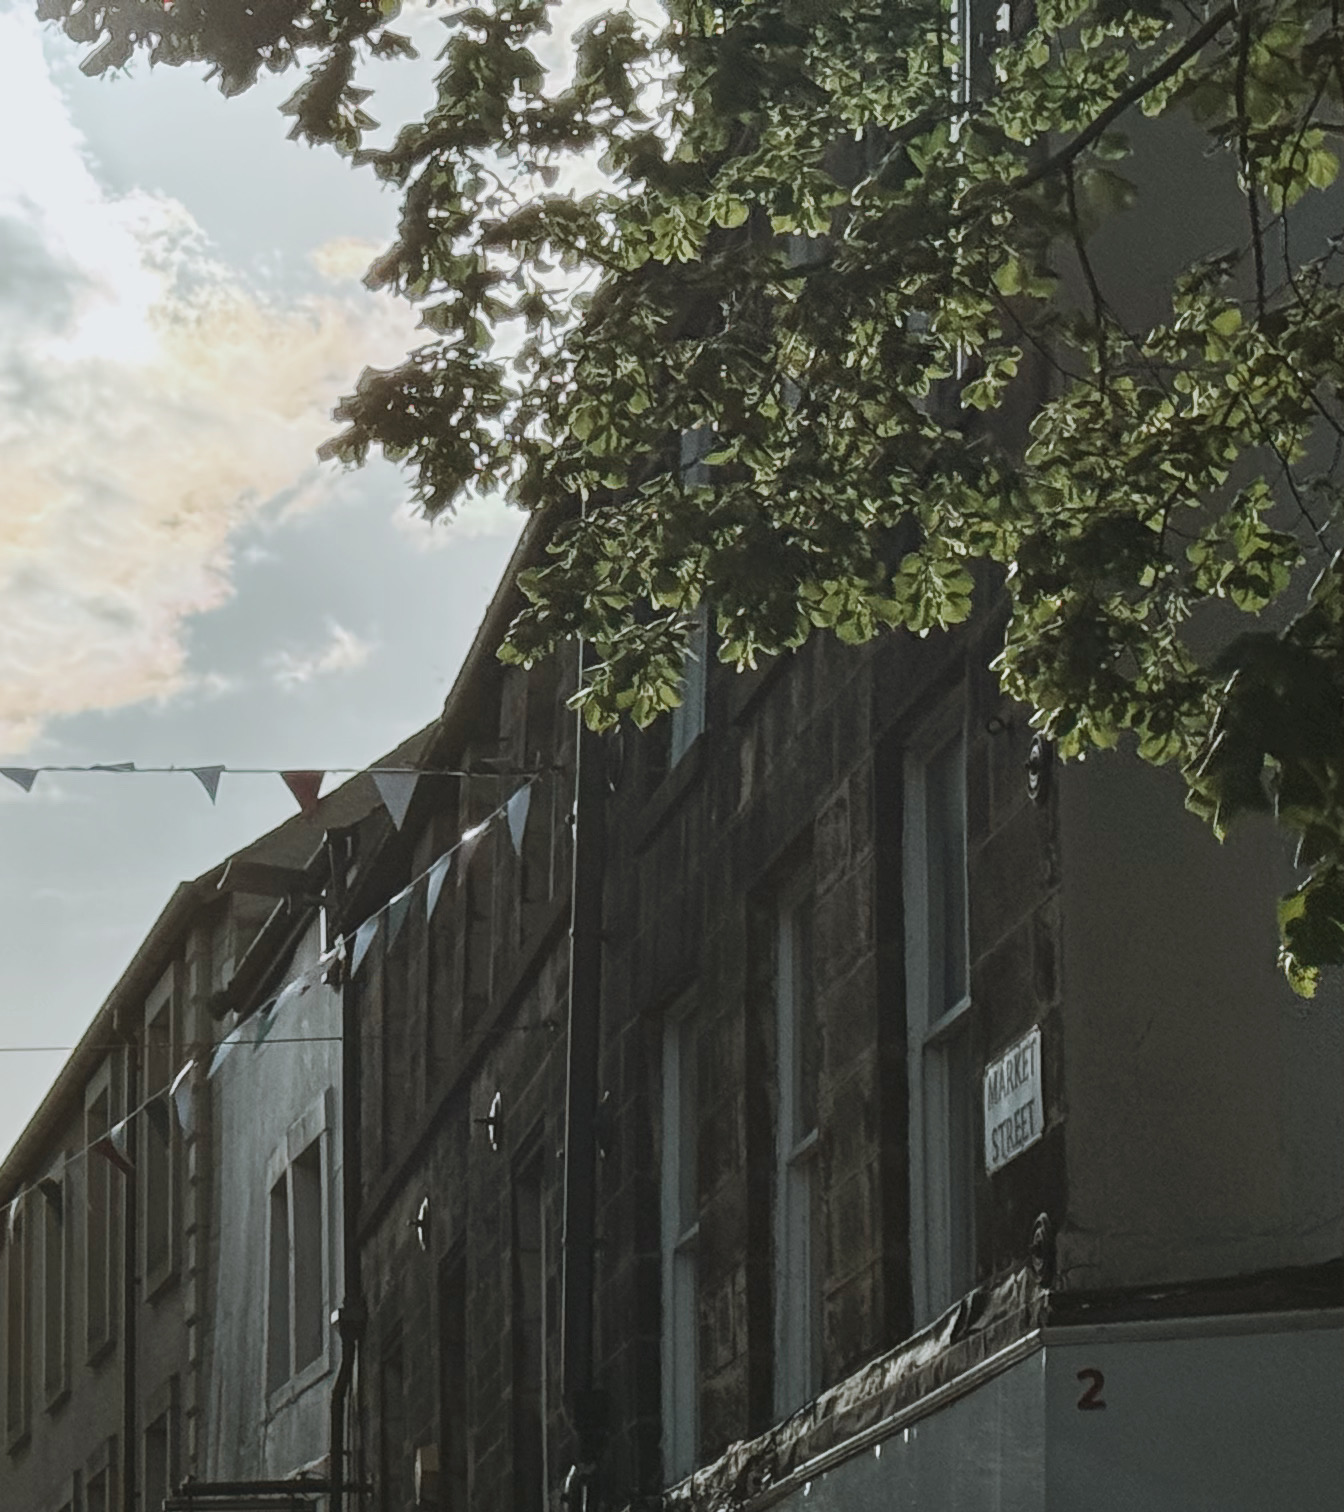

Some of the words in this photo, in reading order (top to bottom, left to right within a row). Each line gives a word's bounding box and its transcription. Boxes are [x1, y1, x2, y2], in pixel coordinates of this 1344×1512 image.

[988, 1036, 1036, 1111] MARKET
[992, 1098, 1036, 1163] STREET
[1077, 1368, 1107, 1411] 2
